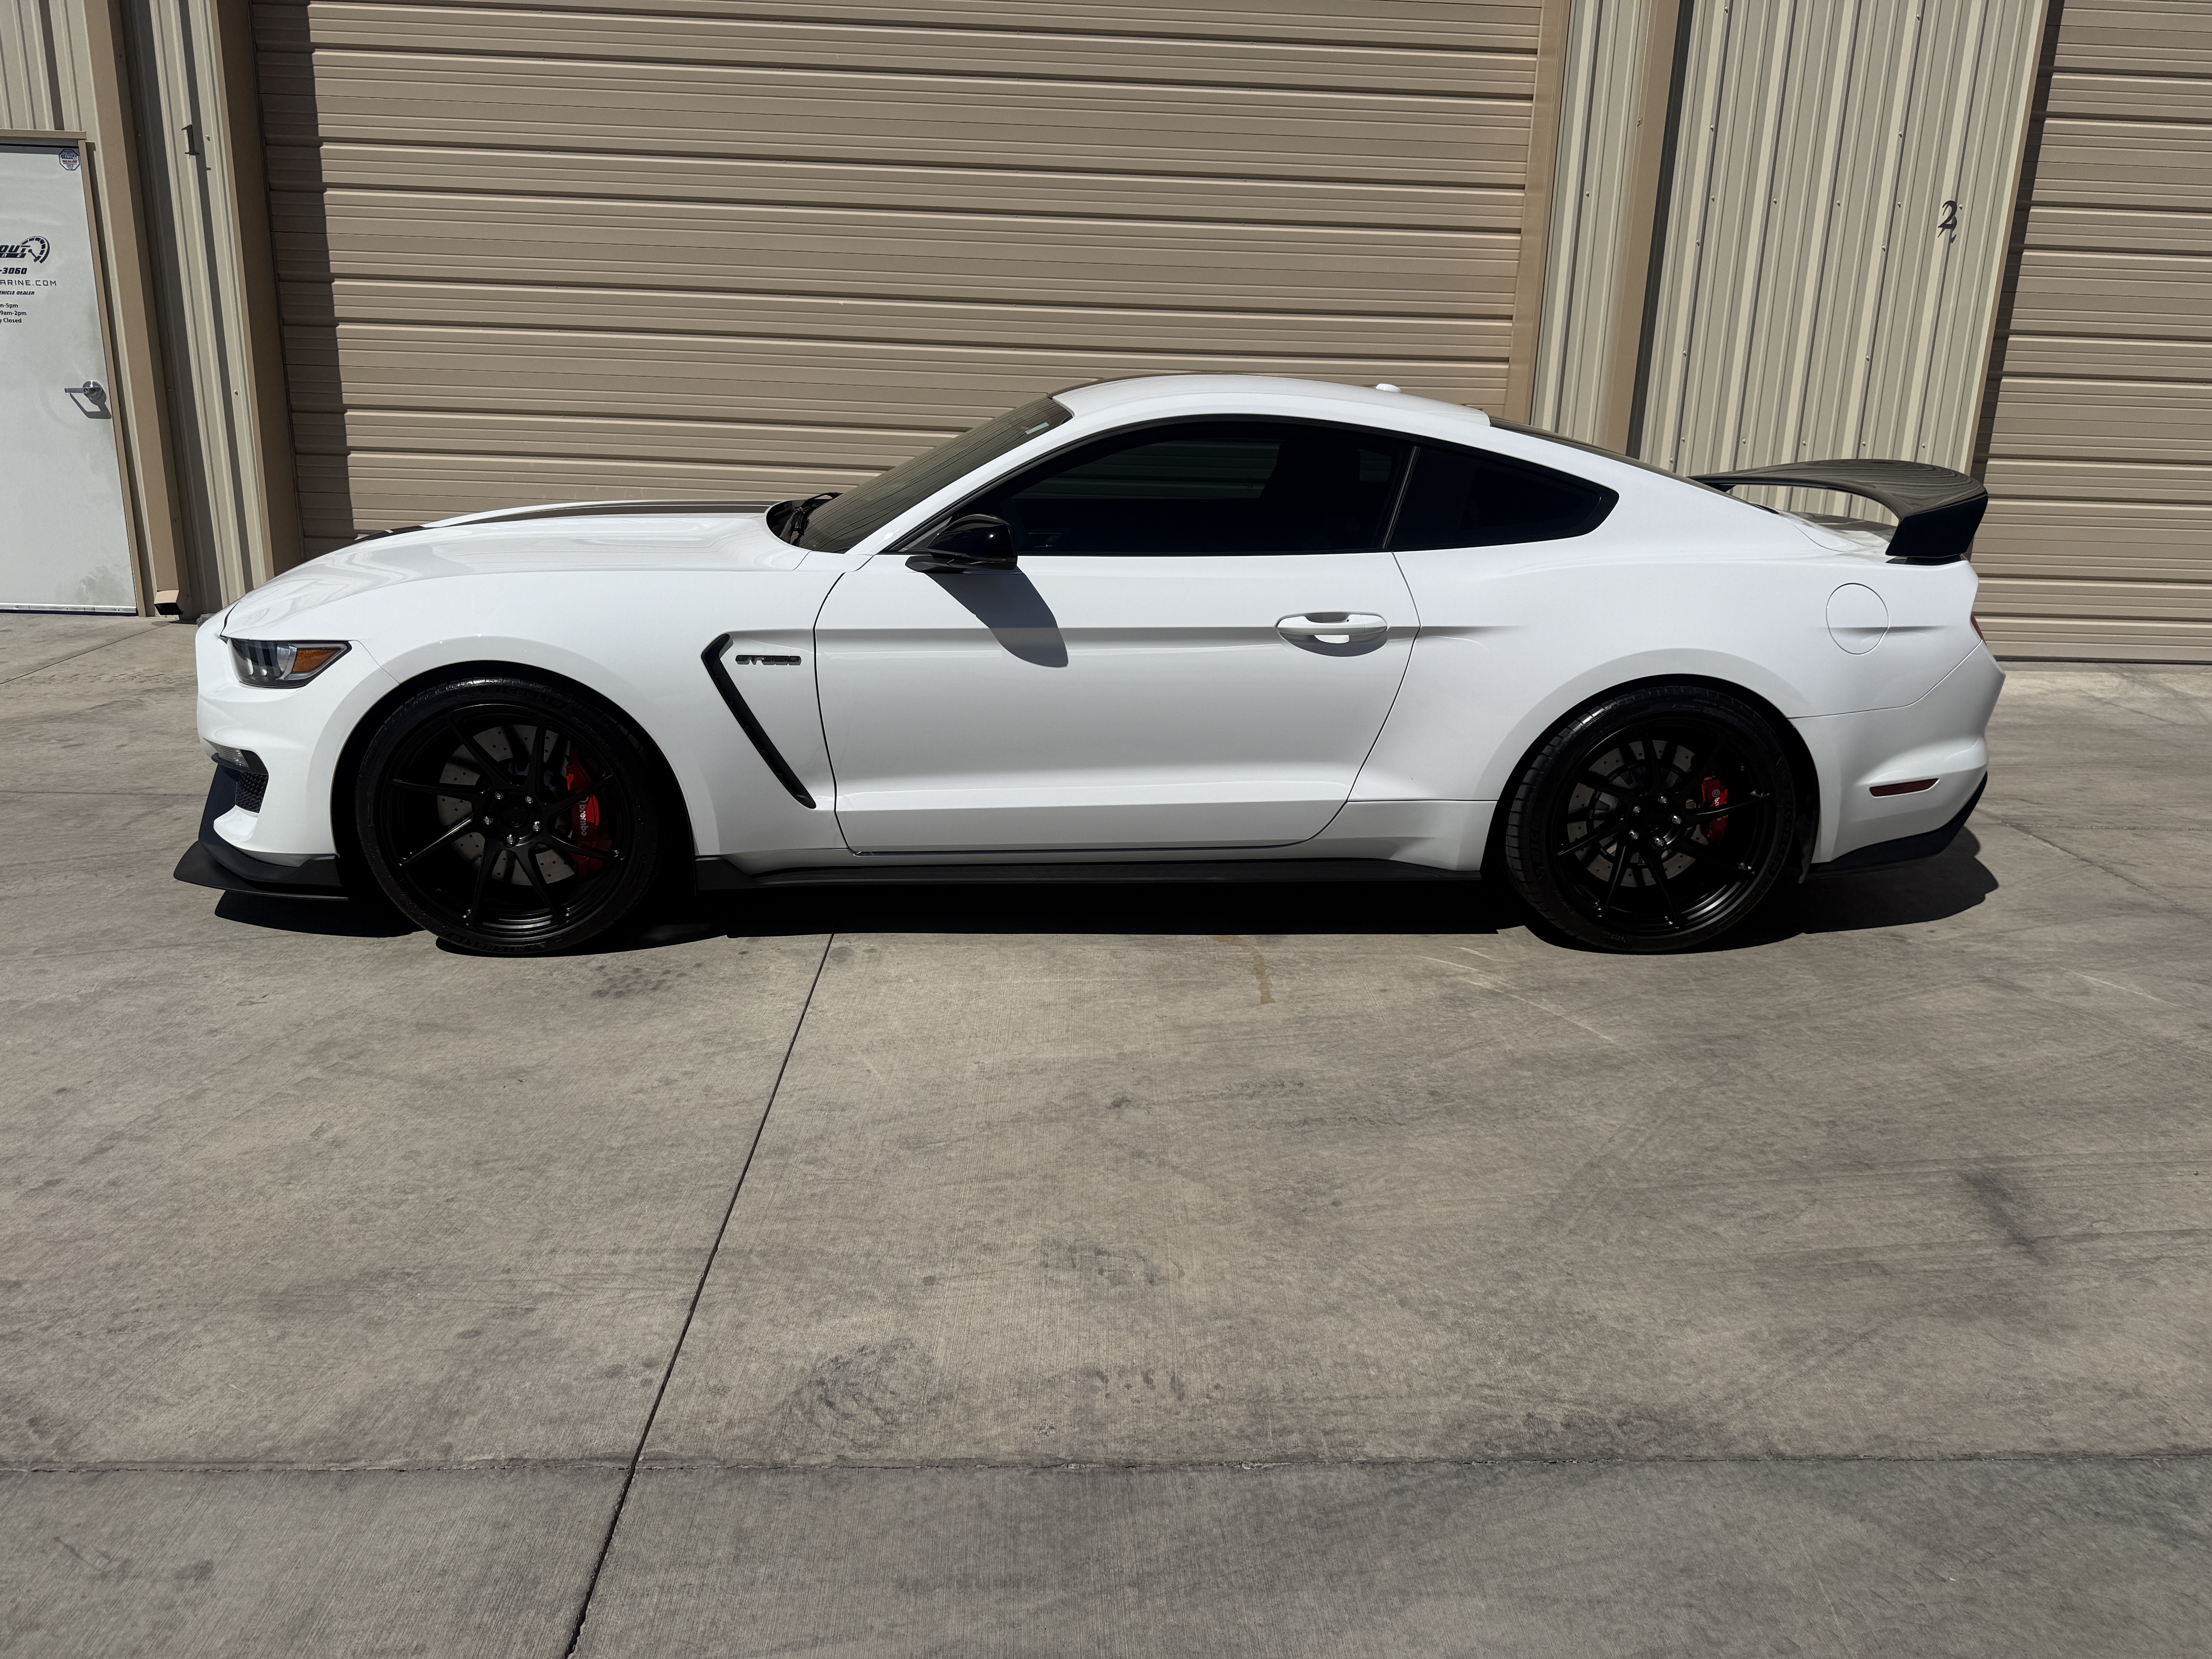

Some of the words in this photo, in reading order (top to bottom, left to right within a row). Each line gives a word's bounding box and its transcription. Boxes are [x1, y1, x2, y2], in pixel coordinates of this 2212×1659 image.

[181, 124, 200, 156] 1
[1937, 200, 1957, 232] 2
[579, 804, 589, 836] brembo
